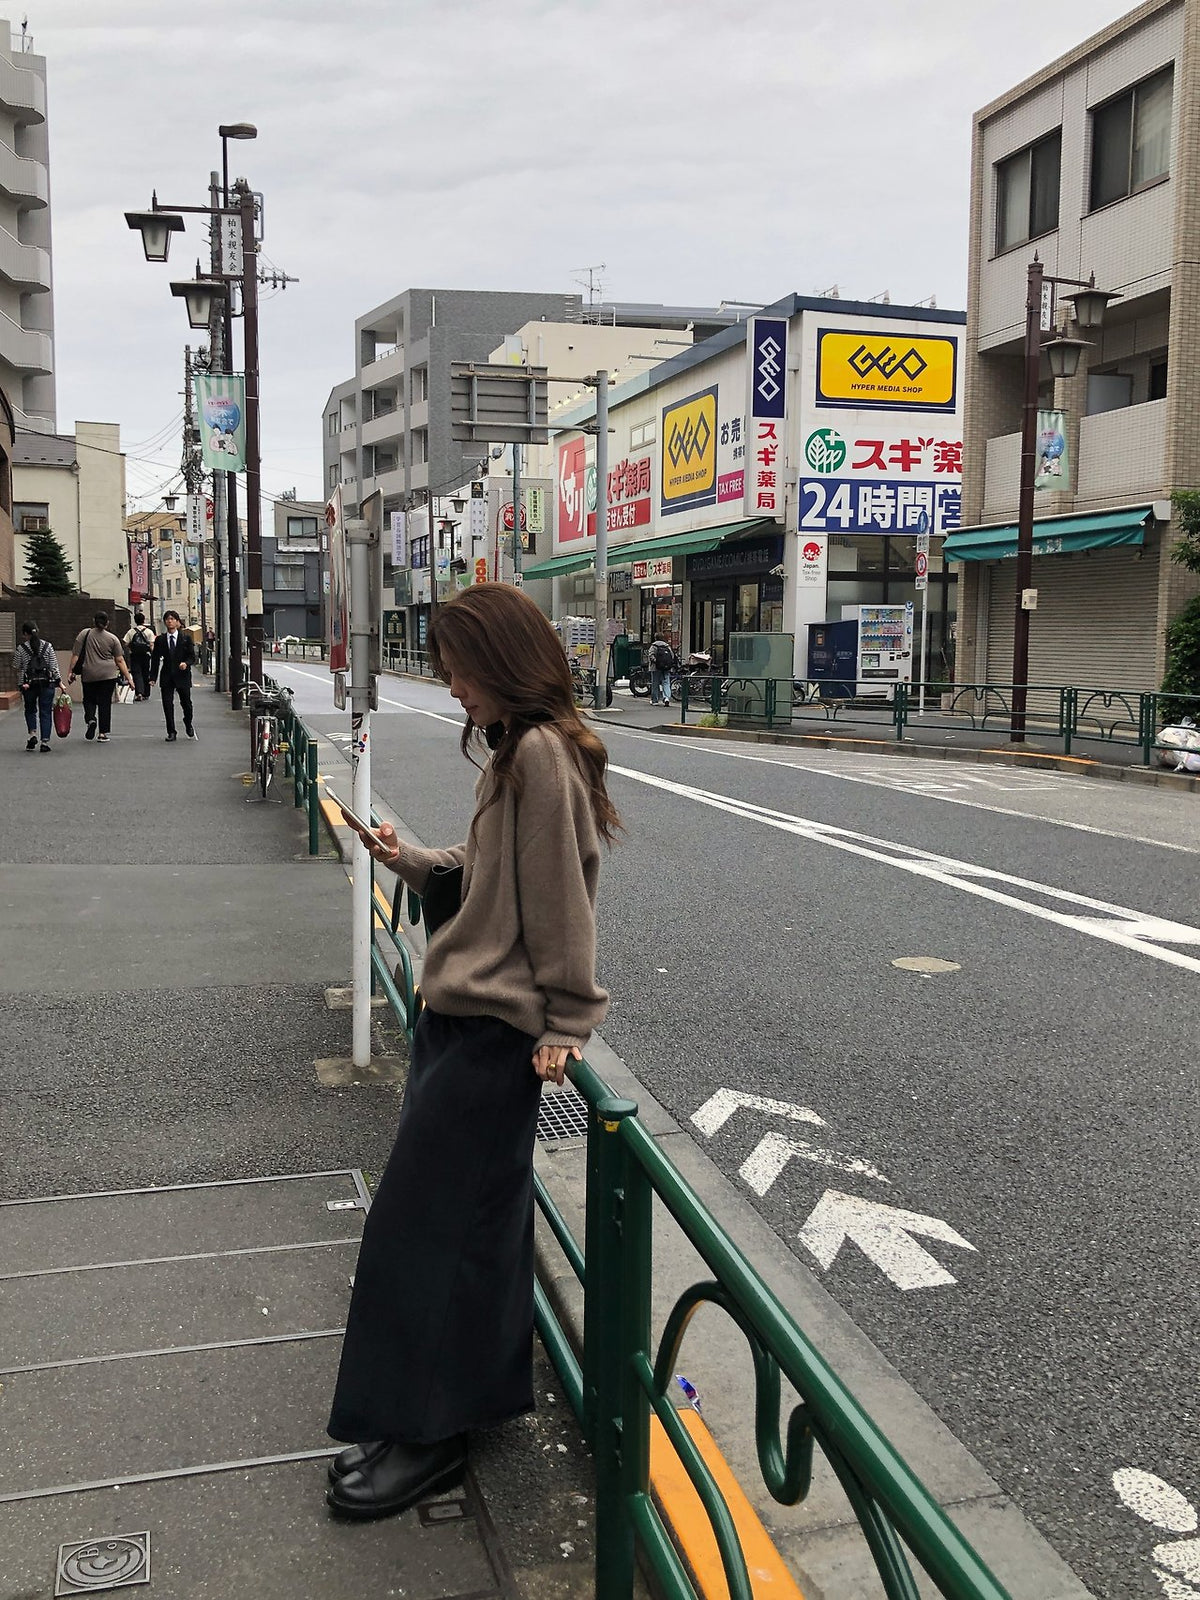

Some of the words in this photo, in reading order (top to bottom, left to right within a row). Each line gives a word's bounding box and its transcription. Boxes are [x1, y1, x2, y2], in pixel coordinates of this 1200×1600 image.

[227, 218, 237, 272] 柏木親友会
[758, 336, 781, 402] GEO
[847, 344, 928, 381] GEO
[851, 383, 875, 391] HYPER
[668, 411, 711, 469] GEO
[720, 415, 746, 445] お売
[696, 469, 708, 481] SHOP
[757, 423, 779, 510] スギ薬局
[559, 449, 584, 532] くすり
[719, 481, 728, 495] TAX
[729, 478, 742, 493] FREE
[653, 561, 671, 576] スギ薬局
